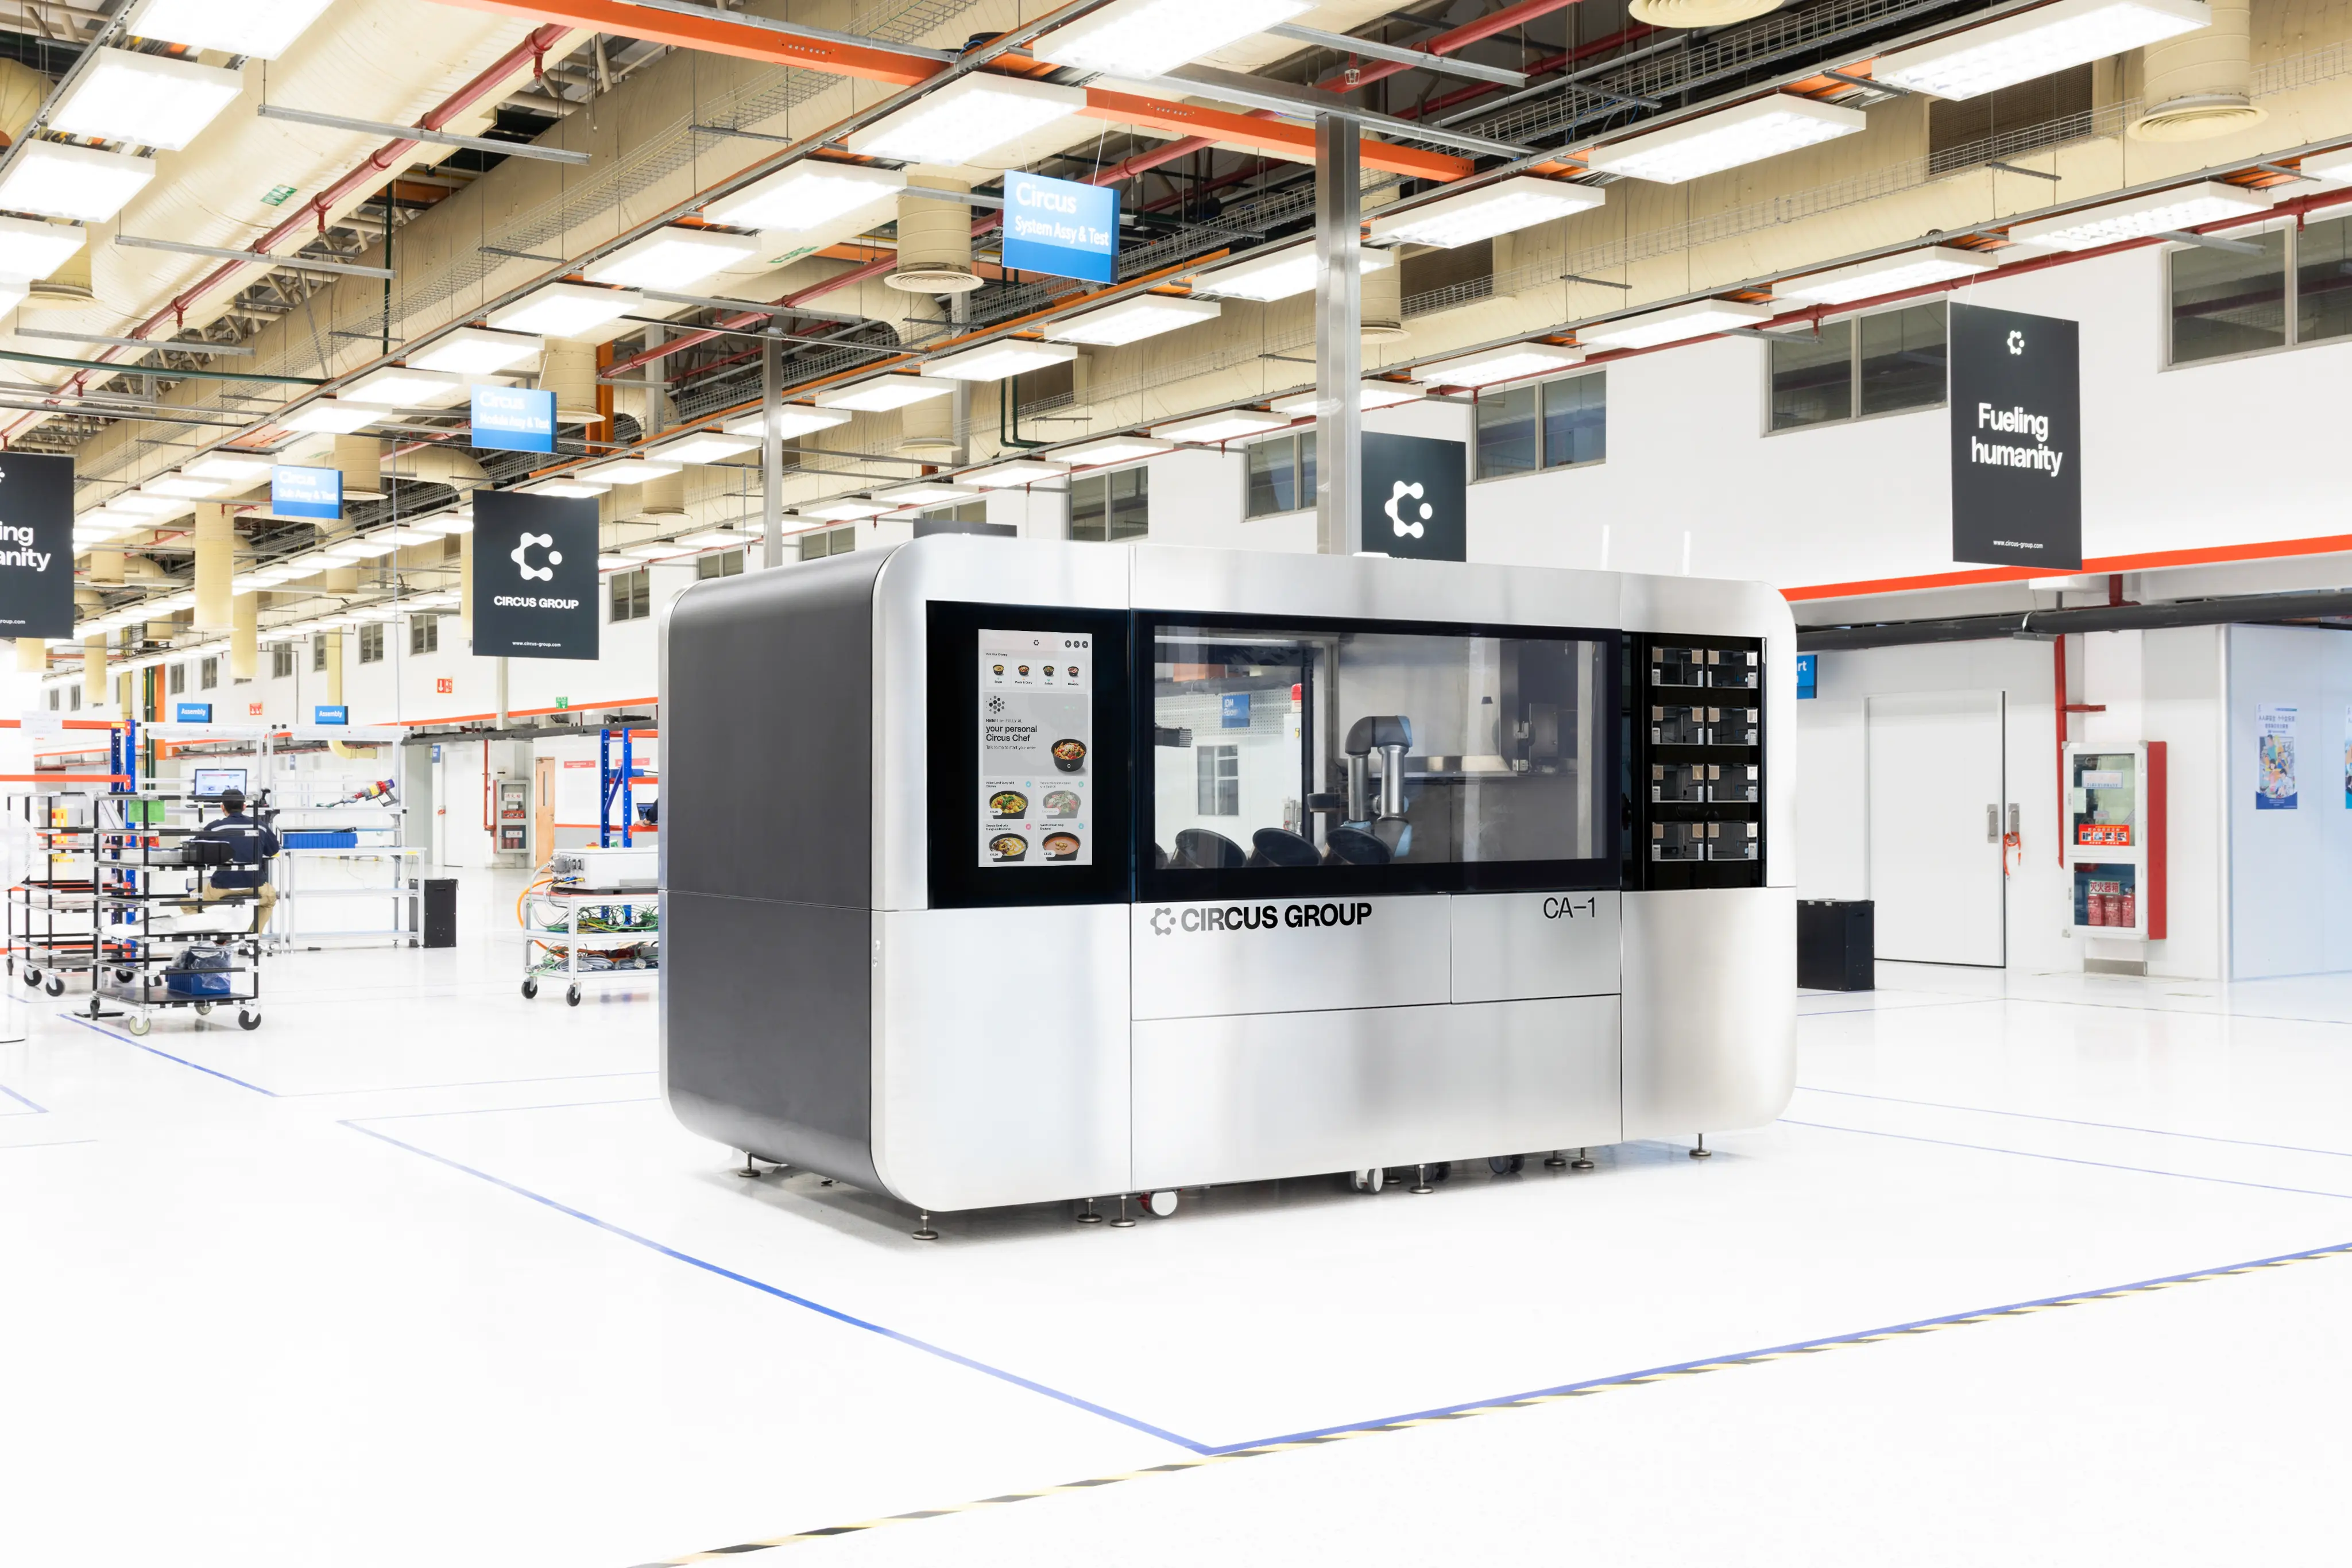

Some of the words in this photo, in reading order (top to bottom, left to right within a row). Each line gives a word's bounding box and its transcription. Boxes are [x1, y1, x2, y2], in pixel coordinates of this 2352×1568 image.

[1016, 182, 1077, 214] Circus
[1015, 215, 1052, 236] System
[1054, 222, 1077, 245] Assy
[1078, 226, 1086, 242] &
[1088, 227, 1109, 246] Test
[479, 392, 525, 409] Circus
[534, 417, 550, 429] Test
[1978, 402, 2048, 442] Fueling
[1971, 436, 2063, 478] humanity
[321, 491, 337, 501] Test
[1993, 540, 2043, 549] www.circus-group.com
[494, 595, 537, 607] CIRCUS
[539, 598, 579, 610] GROUP
[181, 708, 206, 717] Assembly
[319, 710, 343, 718] Assembly
[986, 726, 1003, 734] your
[1005, 725, 1037, 734] personal
[1012, 734, 1030, 742] Chef
[2090, 881, 2119, 893] 灭火器箱
[1181, 905, 1279, 932] CIRCUS
[1285, 902, 1372, 928] GROUP
